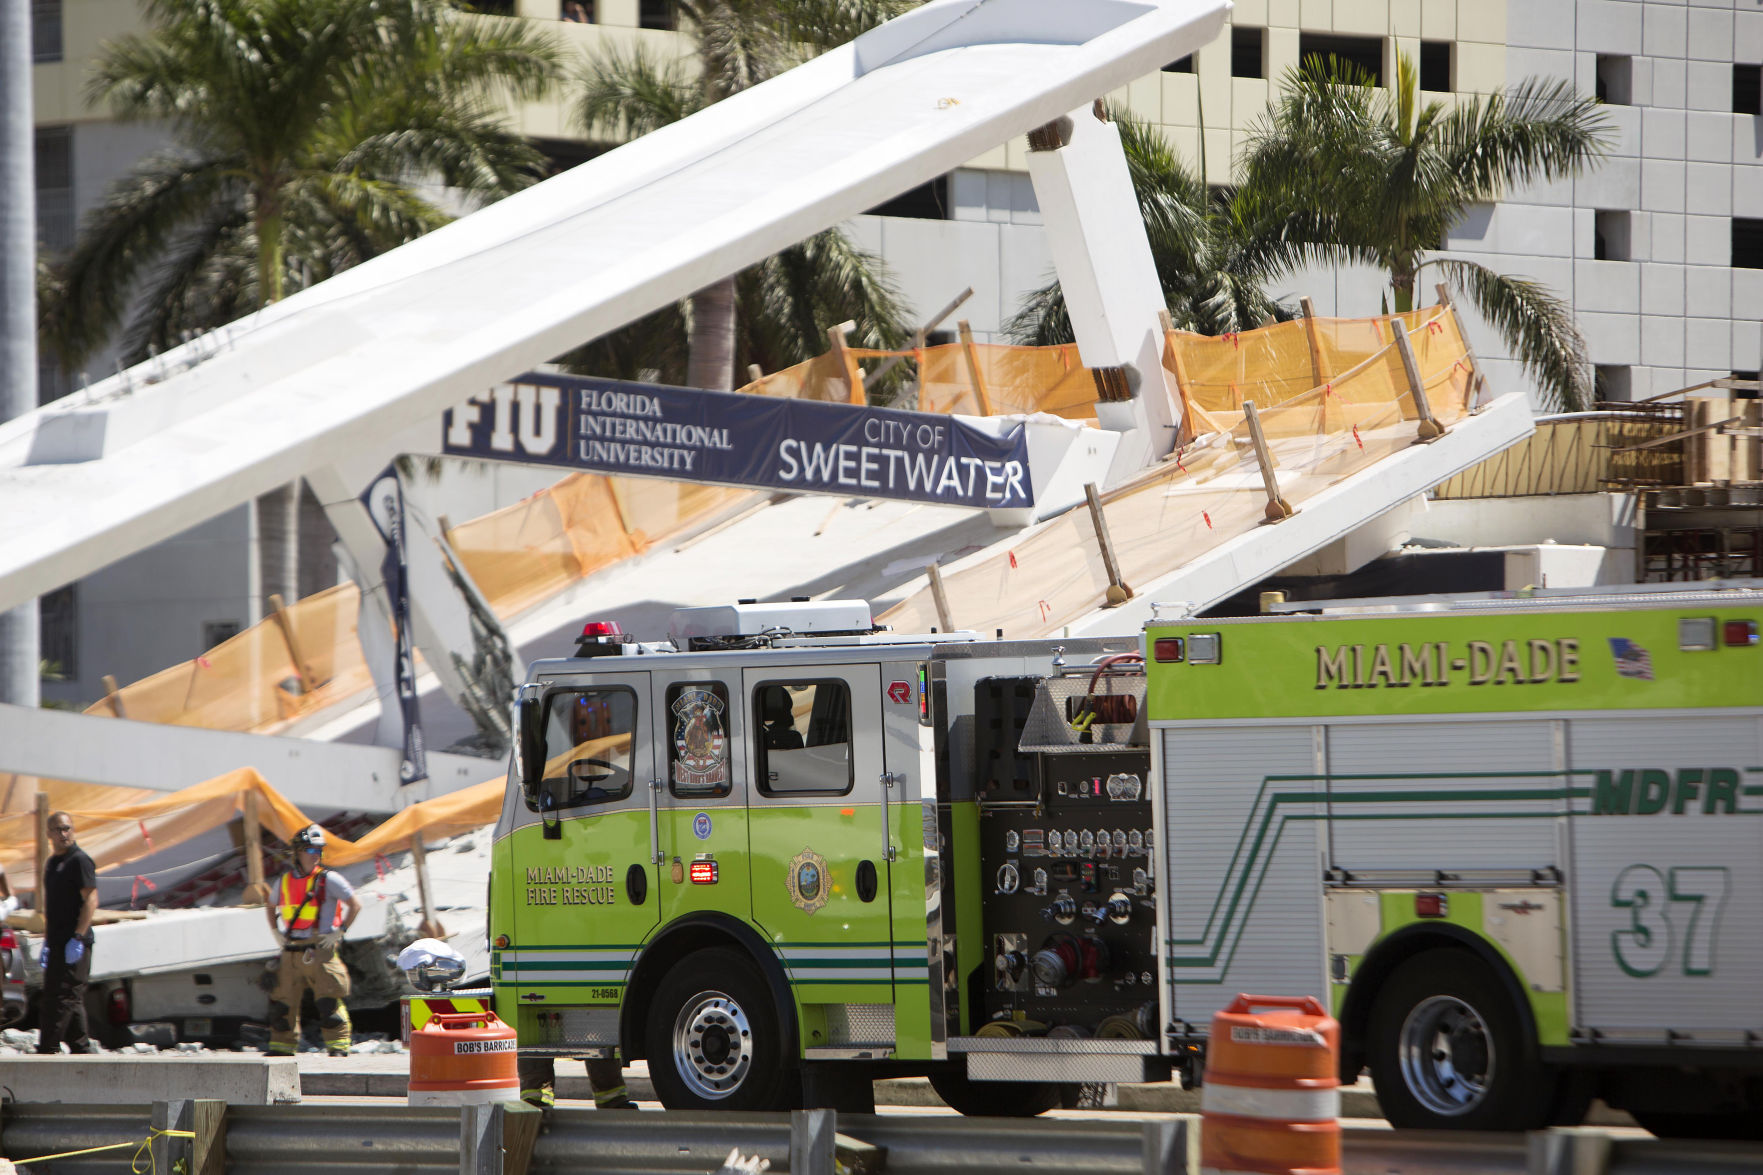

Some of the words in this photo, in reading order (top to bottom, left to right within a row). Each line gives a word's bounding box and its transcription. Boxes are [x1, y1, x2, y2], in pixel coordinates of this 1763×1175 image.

[447, 383, 561, 455] FIU
[580, 389, 663, 417] FLORIDA
[580, 414, 733, 448] INTERNATIONAL
[864, 417, 912, 446] CITY
[916, 424, 944, 449] OF
[580, 439, 696, 471] UNIVERSITY
[778, 438, 1027, 505] SWEETWATER
[1315, 638, 1580, 690] MIAMI-DADE
[1592, 767, 1740, 816] MDFR
[527, 865, 613, 885] MIAMI-DADE
[527, 887, 557, 906] FIRE
[562, 887, 614, 905] RESCUE
[1611, 864, 1733, 978] 37
[457, 1041, 482, 1053] BOB'S
